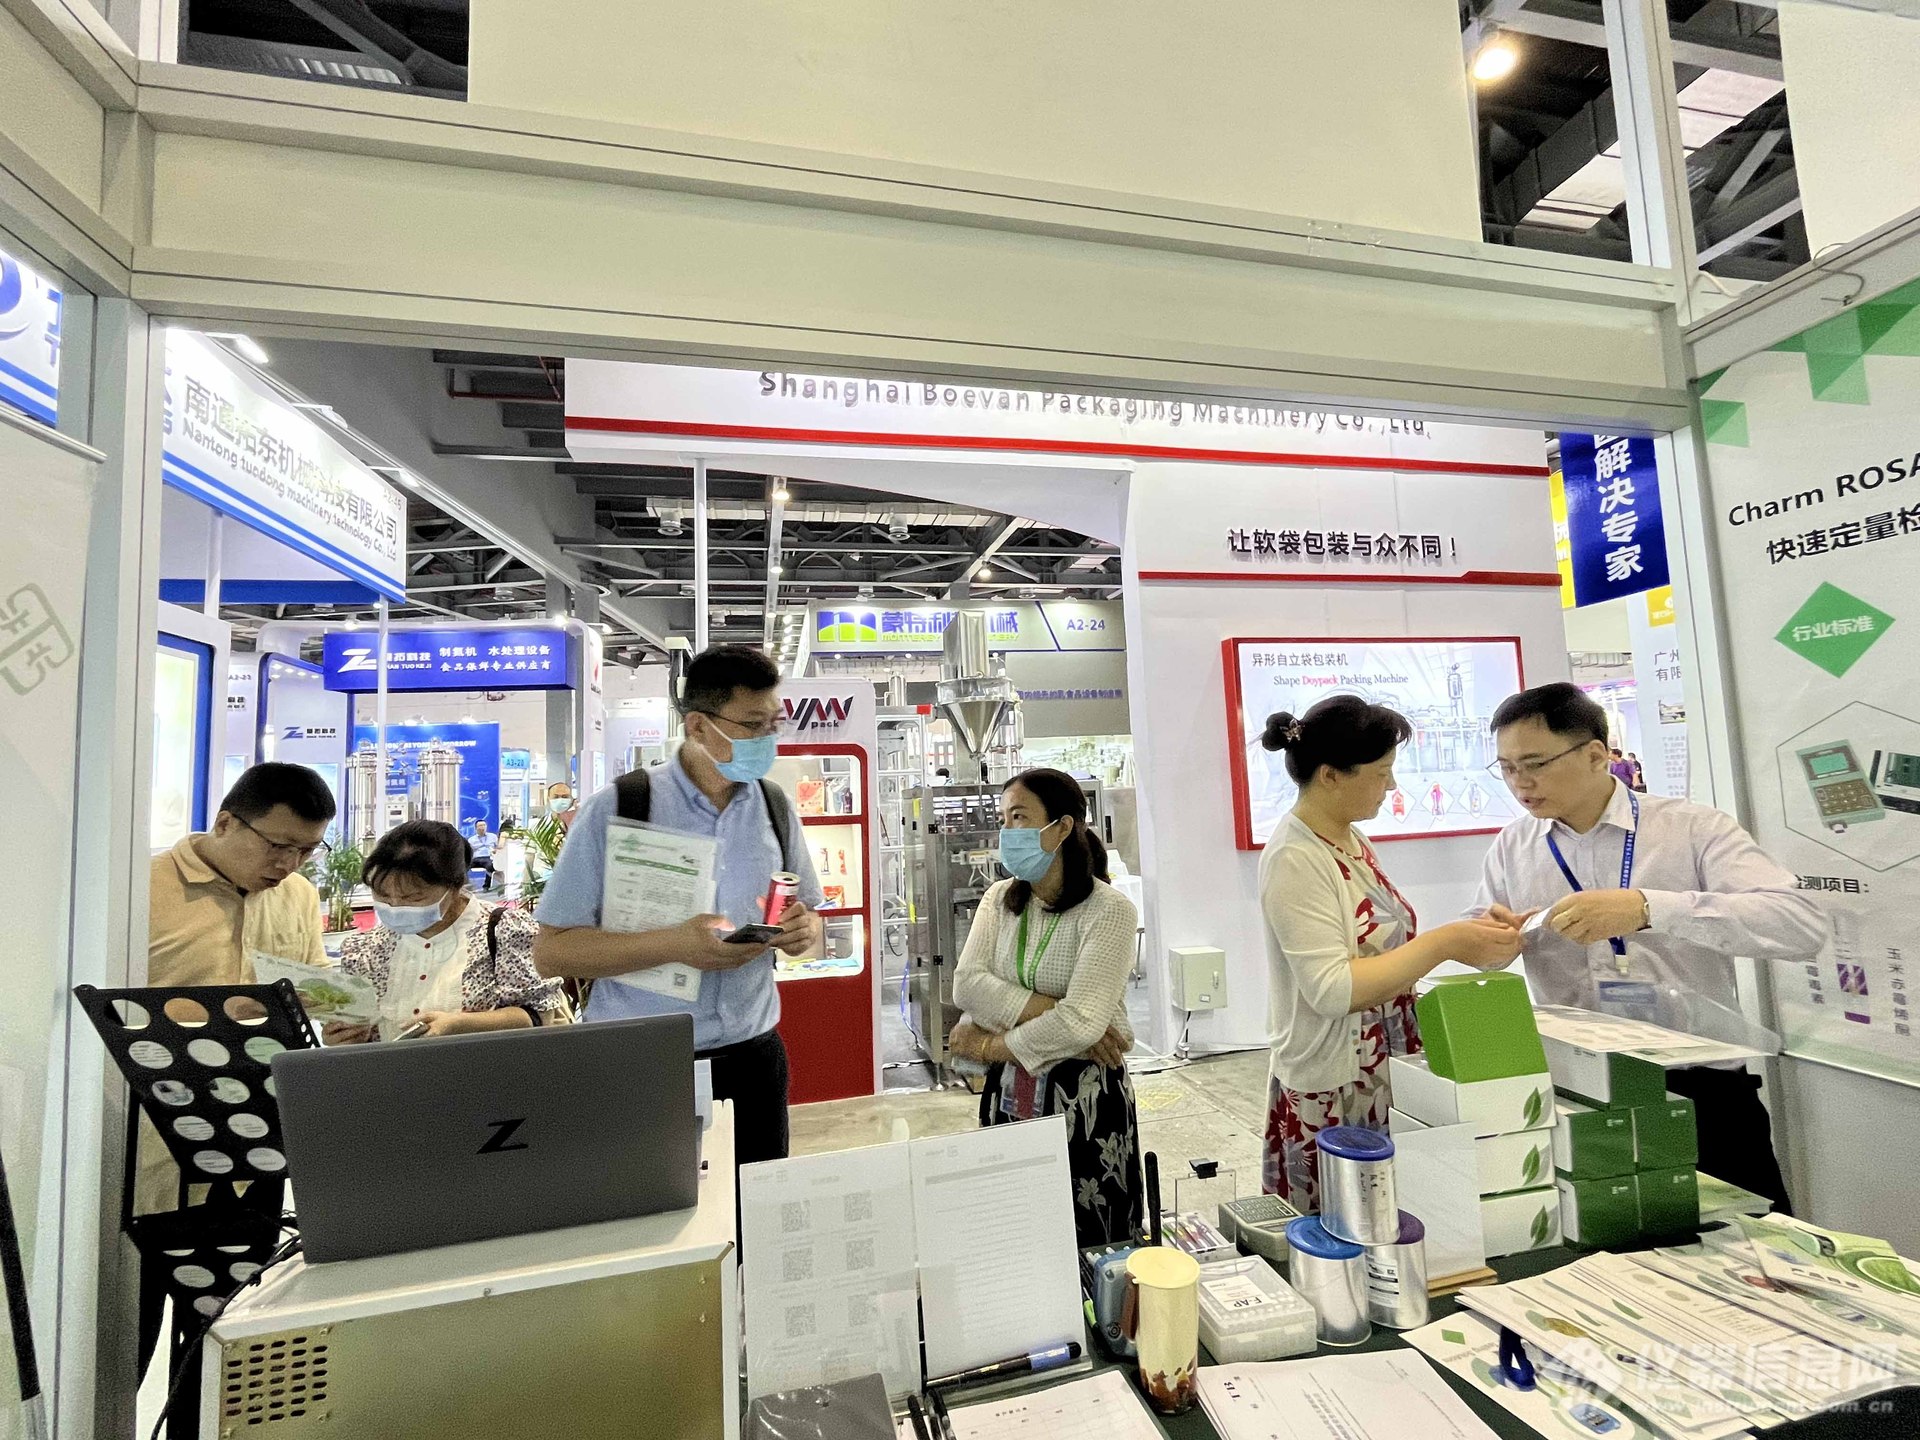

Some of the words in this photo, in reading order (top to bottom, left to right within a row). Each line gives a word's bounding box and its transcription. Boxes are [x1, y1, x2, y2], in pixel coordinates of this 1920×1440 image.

[759, 371, 911, 407] Shanghai
[921, 382, 1030, 411] Boevan
[1040, 392, 1184, 426] Packaging
[182, 417, 238, 468] Nantong
[287, 486, 333, 525] machinery
[333, 514, 372, 549] technology
[1728, 487, 1824, 527] Charm
[1066, 619, 1106, 631] A2-24
[1791, 616, 1875, 642] 行业标准
[488, 645, 551, 657] 水处理设备
[1252, 652, 1349, 667] 异形自立袋包装机
[1273, 675, 1301, 686] Shape
[1302, 674, 1339, 686] Doypack
[1340, 674, 1373, 686] Packing
[1374, 674, 1409, 684] Machine
[811, 720, 840, 729] pack
